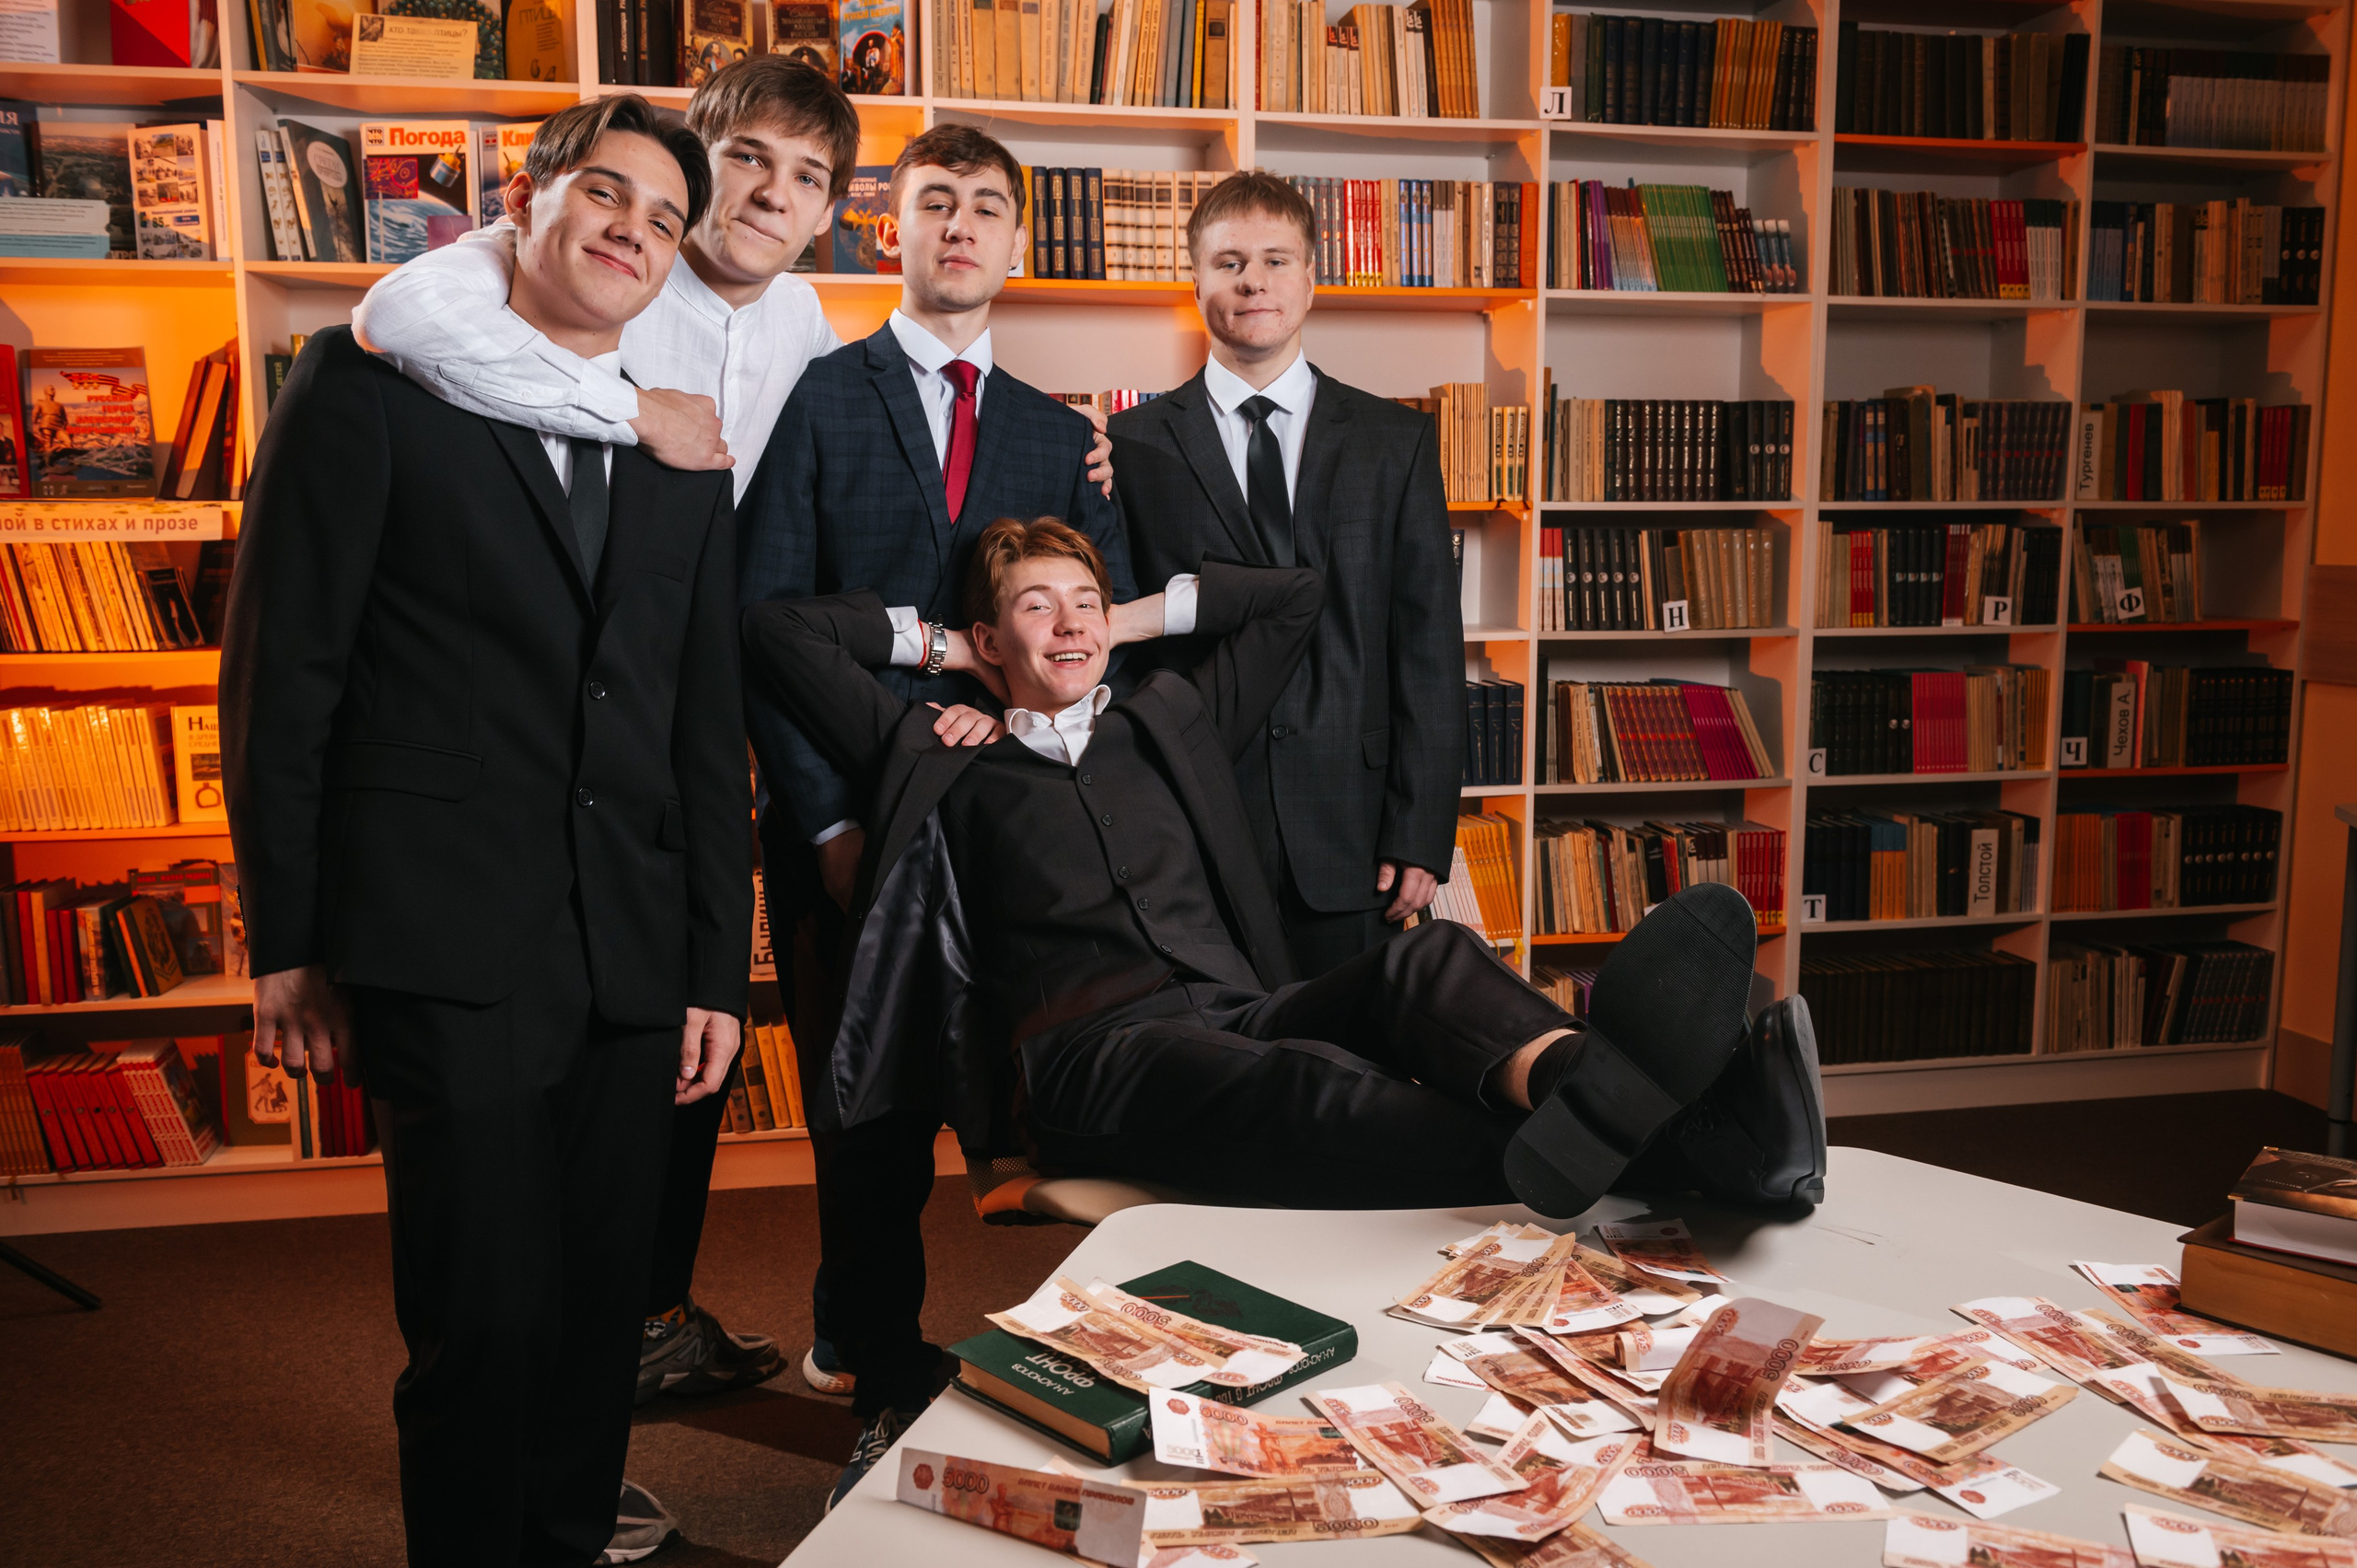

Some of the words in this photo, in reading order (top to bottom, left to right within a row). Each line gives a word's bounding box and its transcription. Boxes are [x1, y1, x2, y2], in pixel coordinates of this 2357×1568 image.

[1544, 92, 1566, 114] Л
[389, 128, 466, 147] Погода
[152, 217, 164, 228] 85
[2080, 422, 2096, 493] Тургенев
[34, 518, 44, 530] в
[52, 518, 118, 530] стихах
[125, 518, 135, 530] и
[144, 517, 198, 534] прозе
[1991, 600, 2008, 621] Р
[2120, 593, 2142, 614] Ф
[1668, 607, 1686, 628] Н
[2117, 690, 2131, 705] А.
[2114, 709, 2131, 757] Чехов
[1808, 752, 1823, 773] С
[2065, 742, 2082, 762] Ч
[1972, 842, 1992, 904] Толстой
[1804, 900, 1822, 918] Т
[754, 879, 774, 965] Были
[1062, 1293, 1088, 1312] 5000
[1120, 1301, 1172, 1328] 5000
[2034, 1304, 2083, 1328] 5000
[2107, 1323, 2157, 1347] 5000
[1761, 1338, 1800, 1381] 5000
[1025, 1353, 1095, 1388] ФРОНТ
[1200, 1405, 1248, 1425] 5000
[1394, 1397, 1435, 1423] 5000
[1827, 1448, 1885, 1475] 5000
[942, 1468, 990, 1493] 5000
[1017, 1477, 1046, 1490] БИЛЕТ
[1048, 1483, 1079, 1496] БАНКА
[1082, 1490, 1135, 1505] ПРИКОЛОВ
[1343, 1476, 1381, 1488] 5000
[1312, 1517, 1379, 1534] 5000
